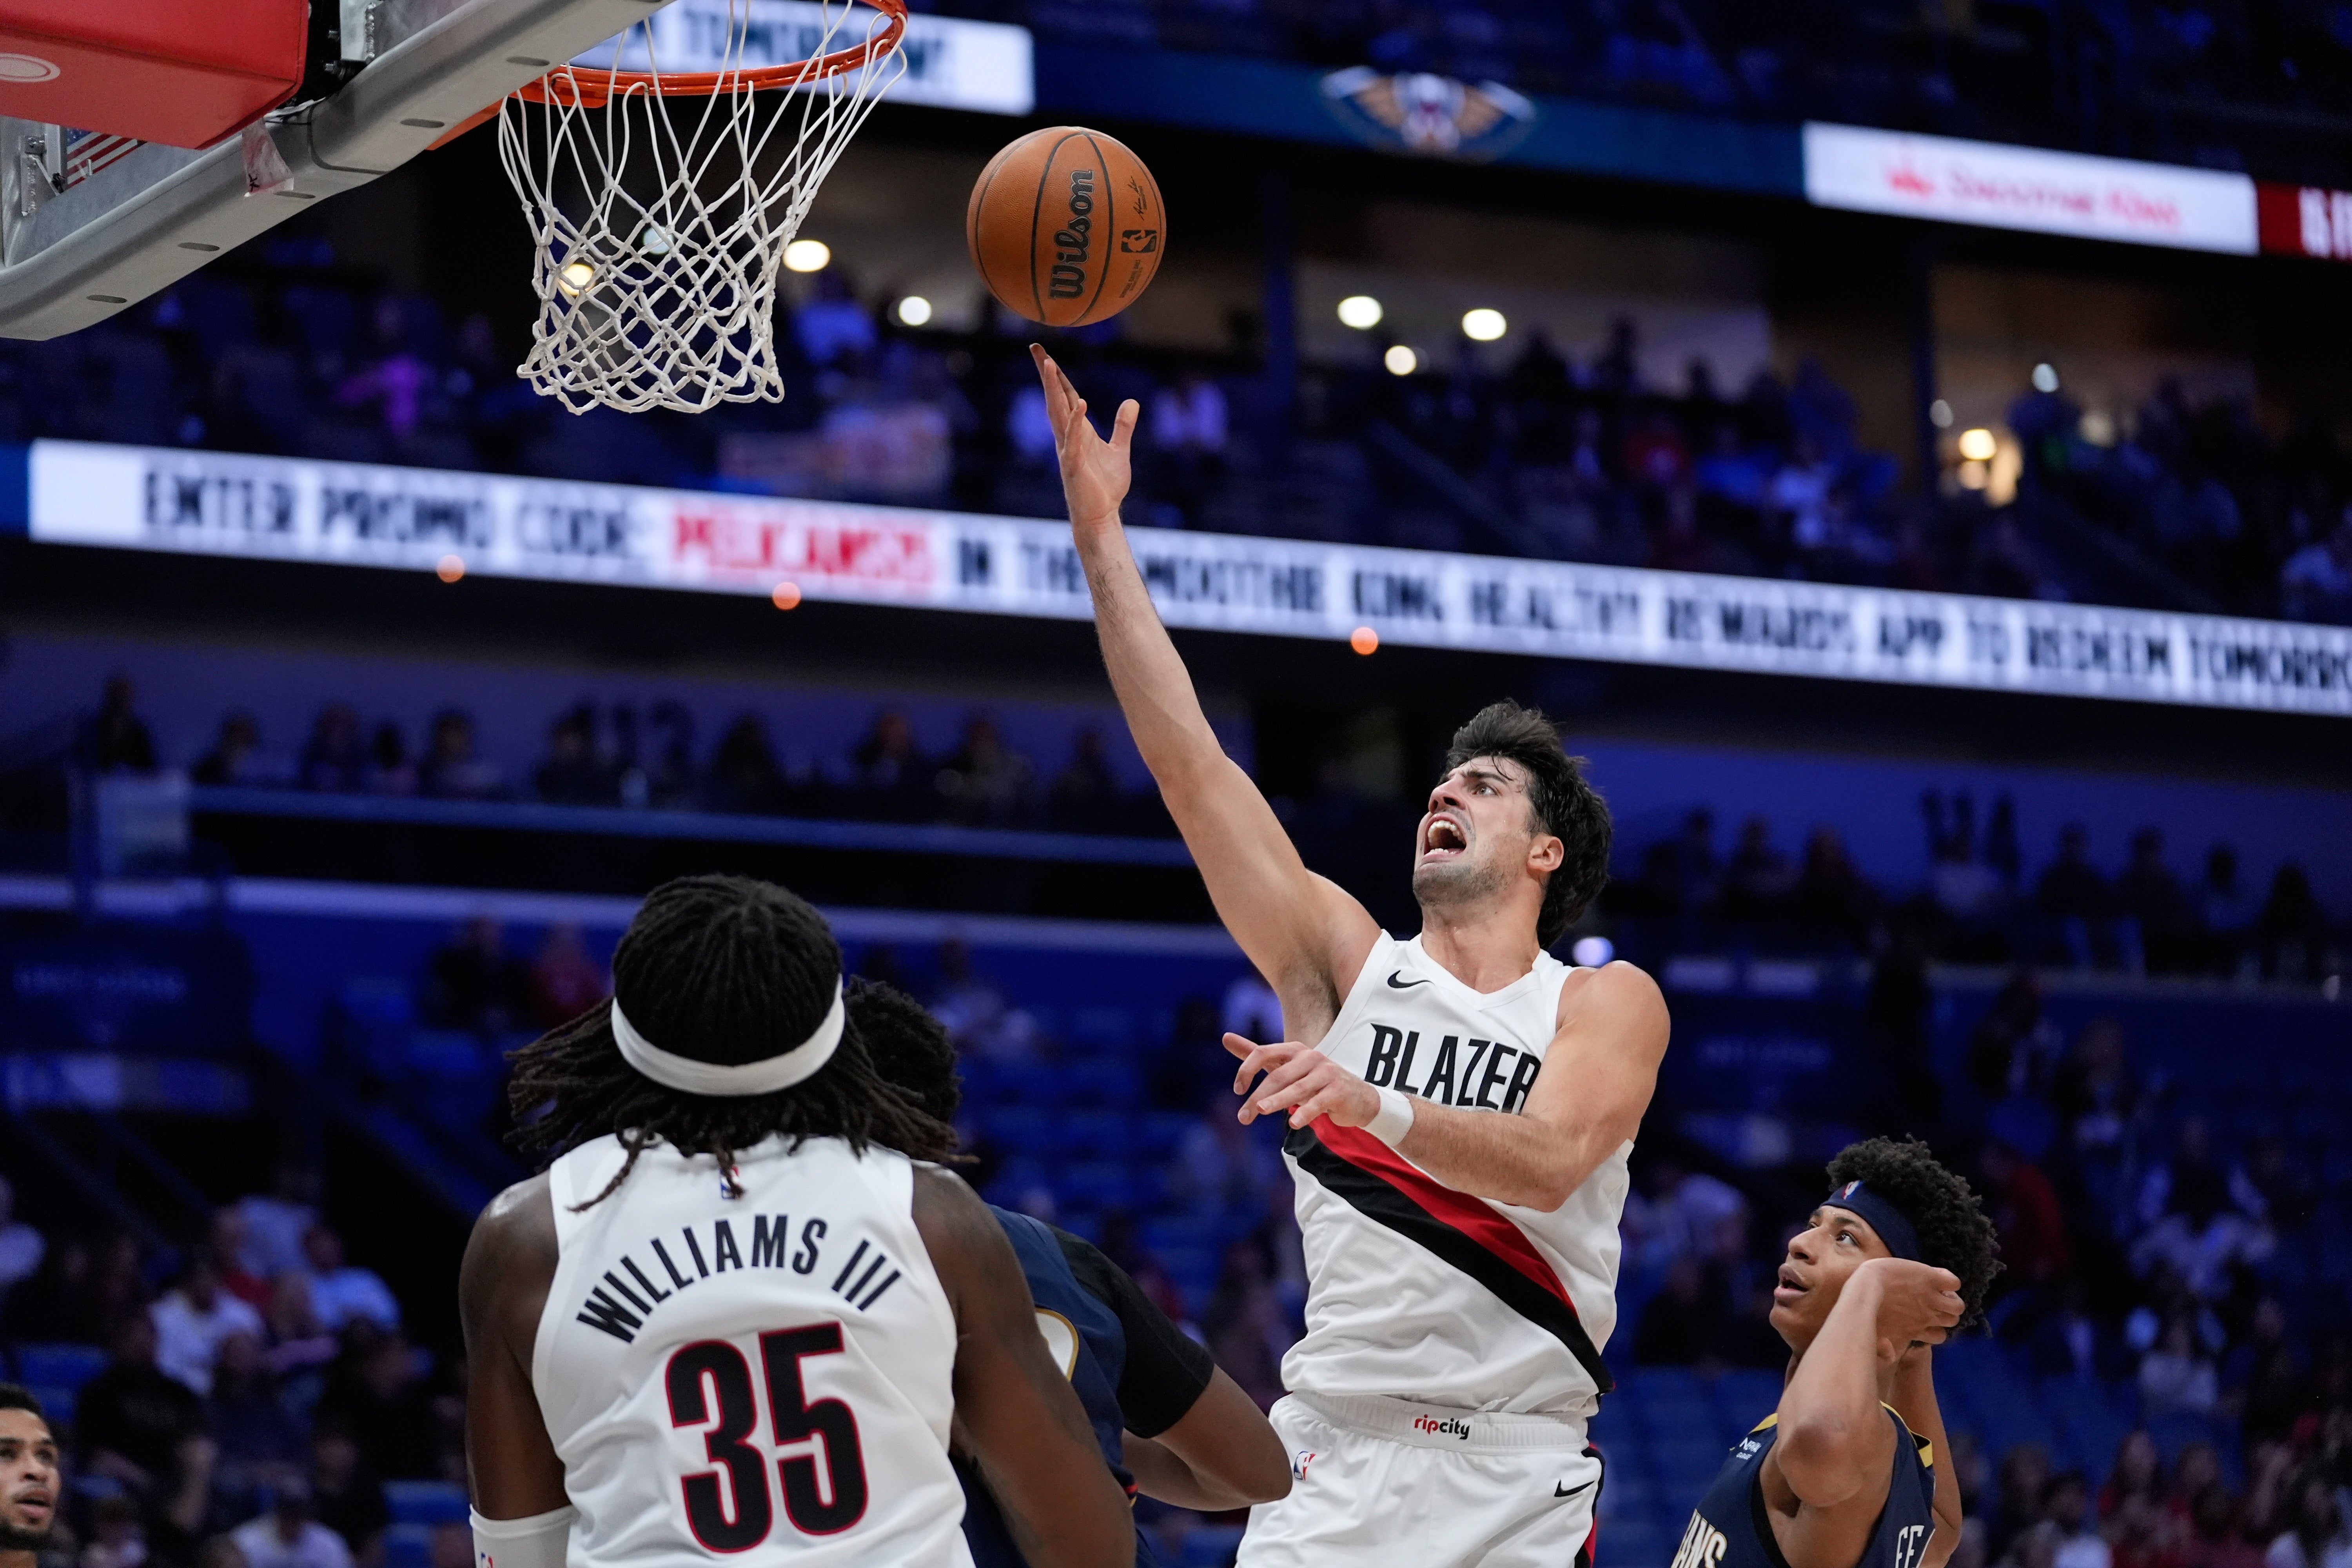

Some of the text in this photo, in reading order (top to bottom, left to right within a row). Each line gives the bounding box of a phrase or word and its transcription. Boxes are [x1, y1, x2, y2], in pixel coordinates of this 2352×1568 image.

[1048, 169, 1094, 299] Wilson
[140, 467, 298, 537] ENTER
[316, 480, 492, 552] PROMO
[954, 529, 997, 588] IN
[1348, 561, 1448, 624] KING
[1466, 570, 1644, 640] HEALTHY
[1661, 586, 1861, 657] REWARDS
[1873, 603, 1951, 663] APP
[1961, 611, 2010, 668] TO
[2021, 615, 2176, 680] REDEEM
[2185, 629, 2352, 693] TOMORRO
[1364, 1023, 1542, 1115] BLAZER
[577, 1214, 901, 1344] WILLIAMS III
[664, 1321, 869, 1554] 35
[1414, 1414, 1470, 1440] ripcity
